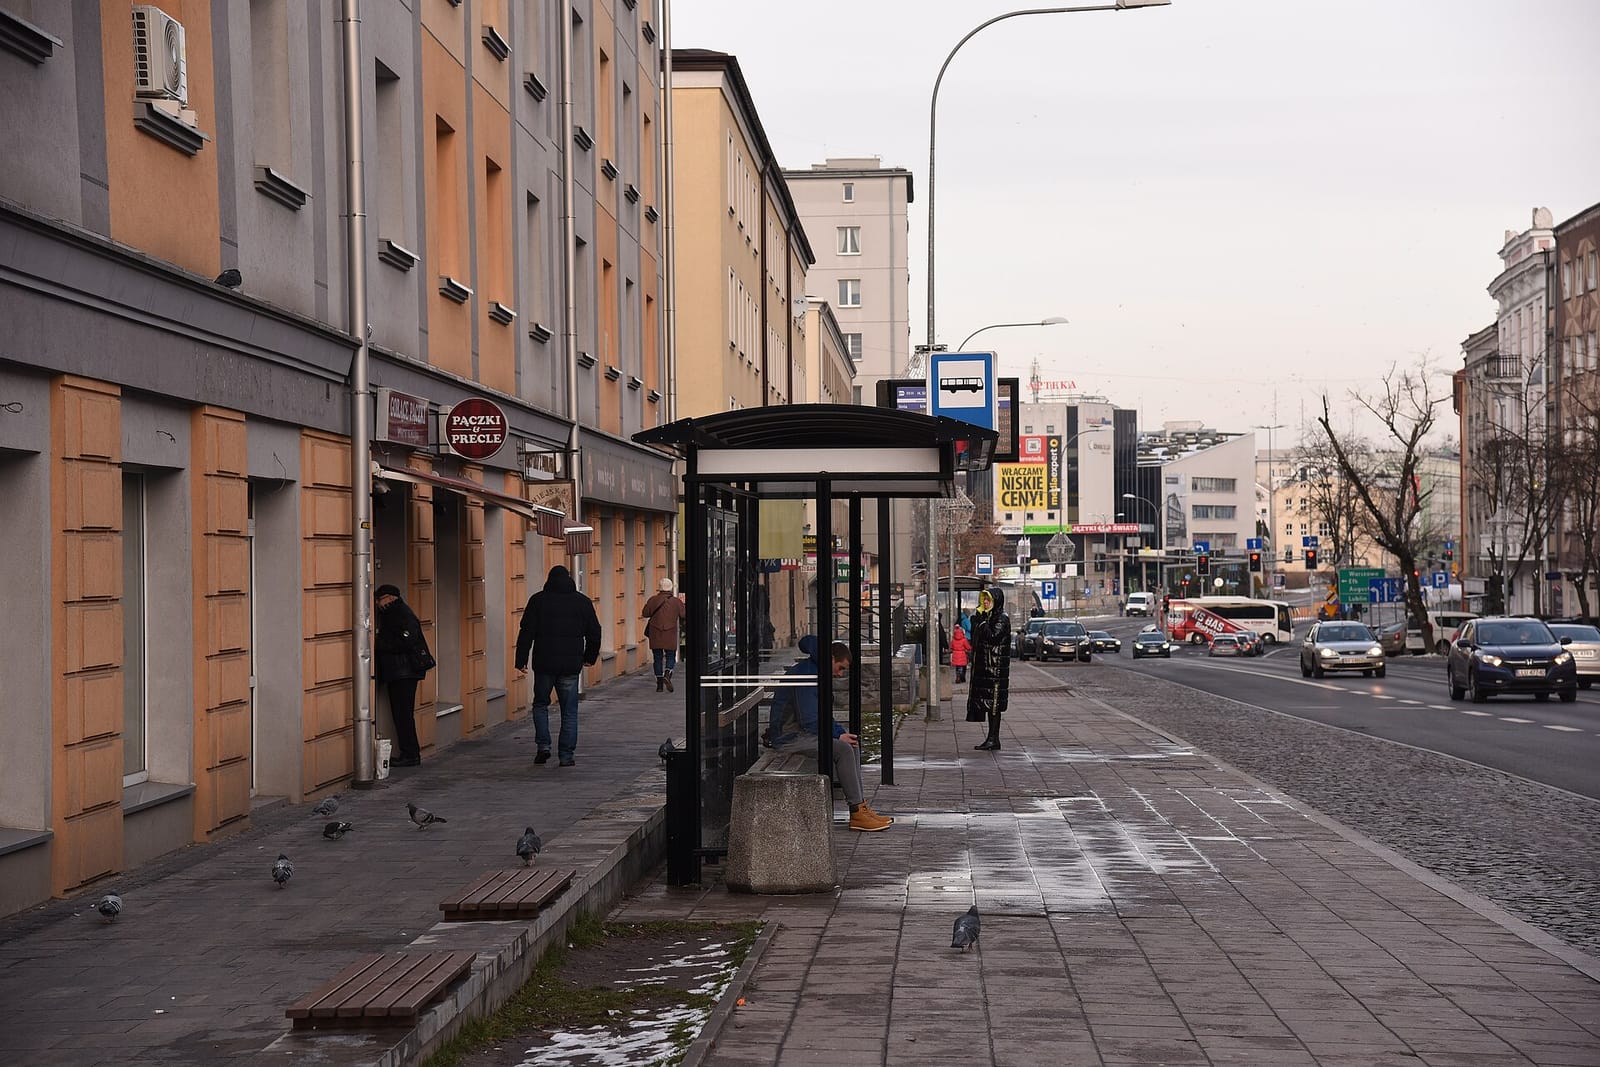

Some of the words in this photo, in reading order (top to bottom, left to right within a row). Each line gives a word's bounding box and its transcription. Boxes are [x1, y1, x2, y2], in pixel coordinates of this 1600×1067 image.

[452, 415, 501, 427] PĄCZKI
[451, 434, 502, 444] PRECLE
[1001, 467, 1044, 476] WŁĄCZAMY
[1001, 476, 1044, 490] NISKIE
[1001, 491, 1044, 507] CENY!
[1204, 616, 1225, 632] BAS
